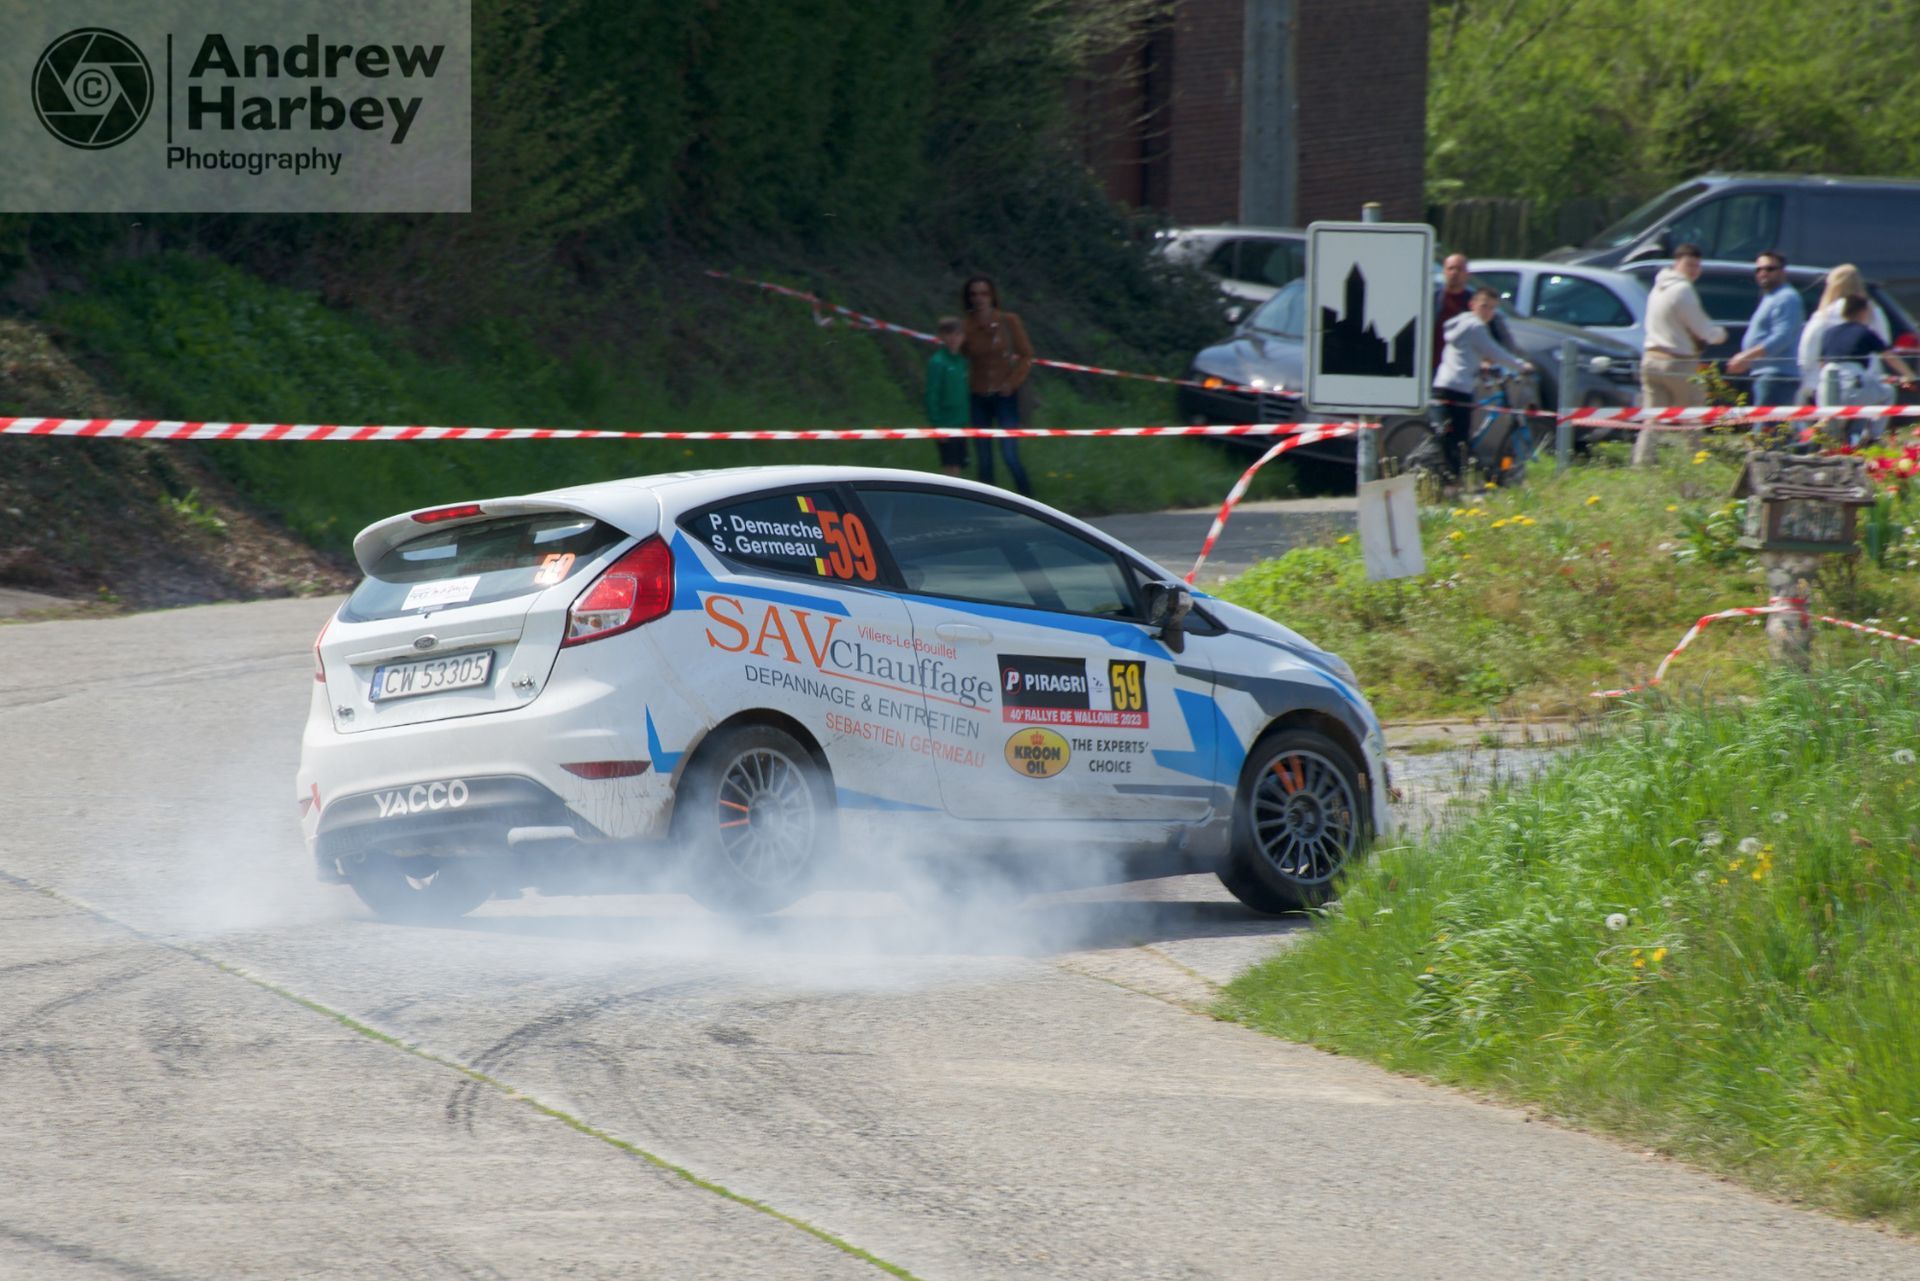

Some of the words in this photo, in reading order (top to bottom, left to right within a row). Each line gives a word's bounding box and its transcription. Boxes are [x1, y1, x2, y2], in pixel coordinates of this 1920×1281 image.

[709, 513, 728, 531] P.
[730, 515, 824, 540] Demarche
[712, 534, 732, 553] S.
[735, 537, 818, 558] Germeau
[816, 510, 878, 582] 59
[704, 594, 842, 669] SAV
[857, 625, 958, 660] Villers-Le-Bouillet
[385, 665, 417, 694] CW
[420, 654, 487, 689] 53305
[830, 639, 993, 709] Chauffage
[1024, 673, 1087, 694] PIRAGRI
[1111, 664, 1142, 710] 59
[744, 664, 856, 710] DEPANNAGE
[861, 694, 872, 712] &
[878, 700, 981, 739] ENTRETIEN
[1024, 710, 1058, 723] RALLYE
[1060, 711, 1073, 722] DE
[1074, 712, 1119, 725] WALLONIE
[1120, 714, 1142, 726] 2023
[825, 712, 906, 750] SEBASTIEN
[910, 735, 987, 769] GERMEAU
[1014, 745, 1062, 761] KROON
[1072, 738, 1093, 752] THE
[1026, 760, 1047, 775] OIL
[1088, 759, 1132, 774] CHOICE
[372, 779, 469, 819] YACCO
